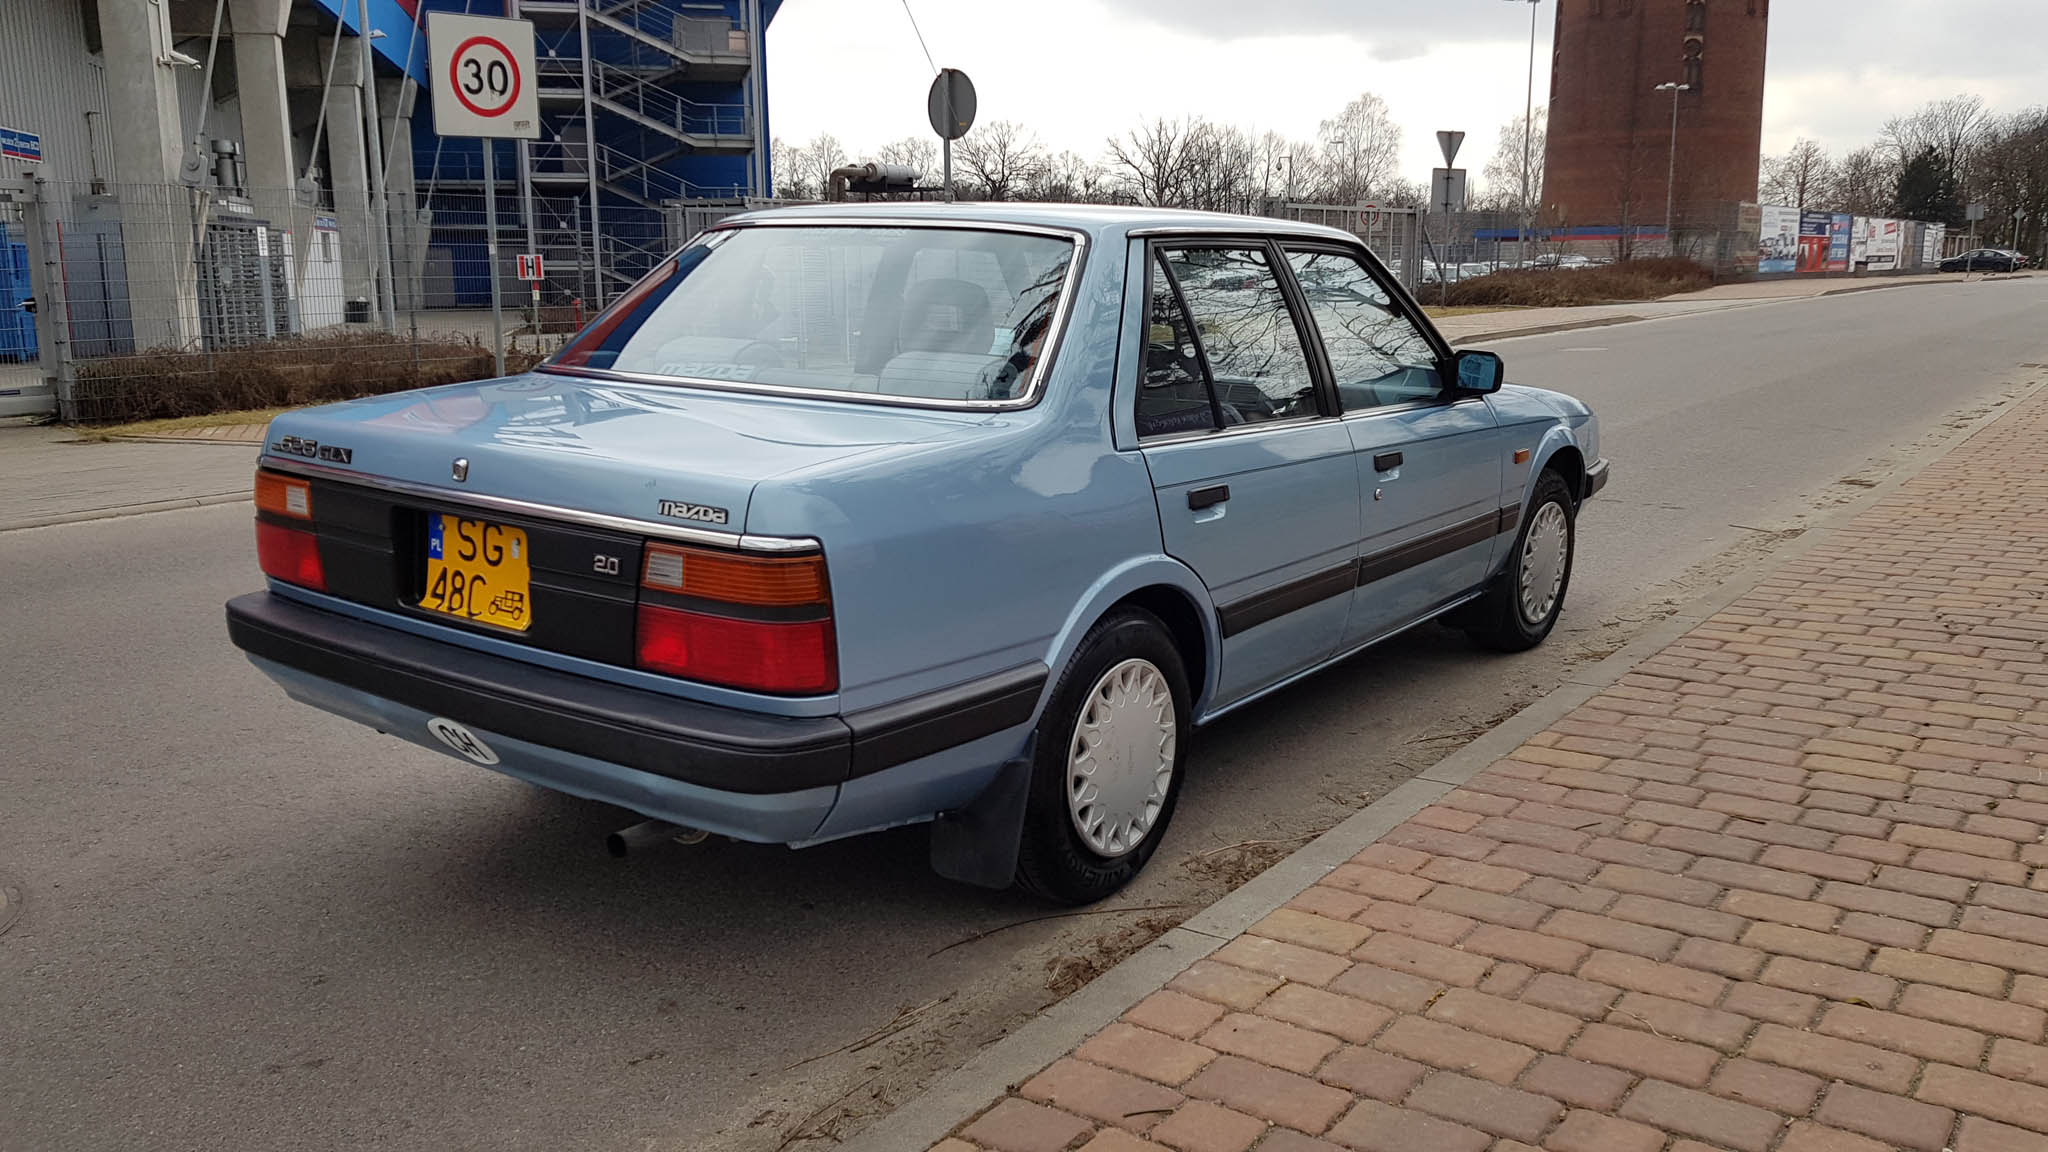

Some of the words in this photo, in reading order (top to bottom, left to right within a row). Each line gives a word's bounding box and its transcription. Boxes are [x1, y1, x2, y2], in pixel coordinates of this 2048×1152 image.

[463, 57, 509, 97] 30
[525, 256, 535, 277] H
[281, 434, 318, 457] 626
[318, 445, 352, 464] GLX
[431, 538, 442, 552] PL
[457, 518, 504, 567] SG
[430, 566, 487, 618] 48C
[438, 724, 490, 761] CH
